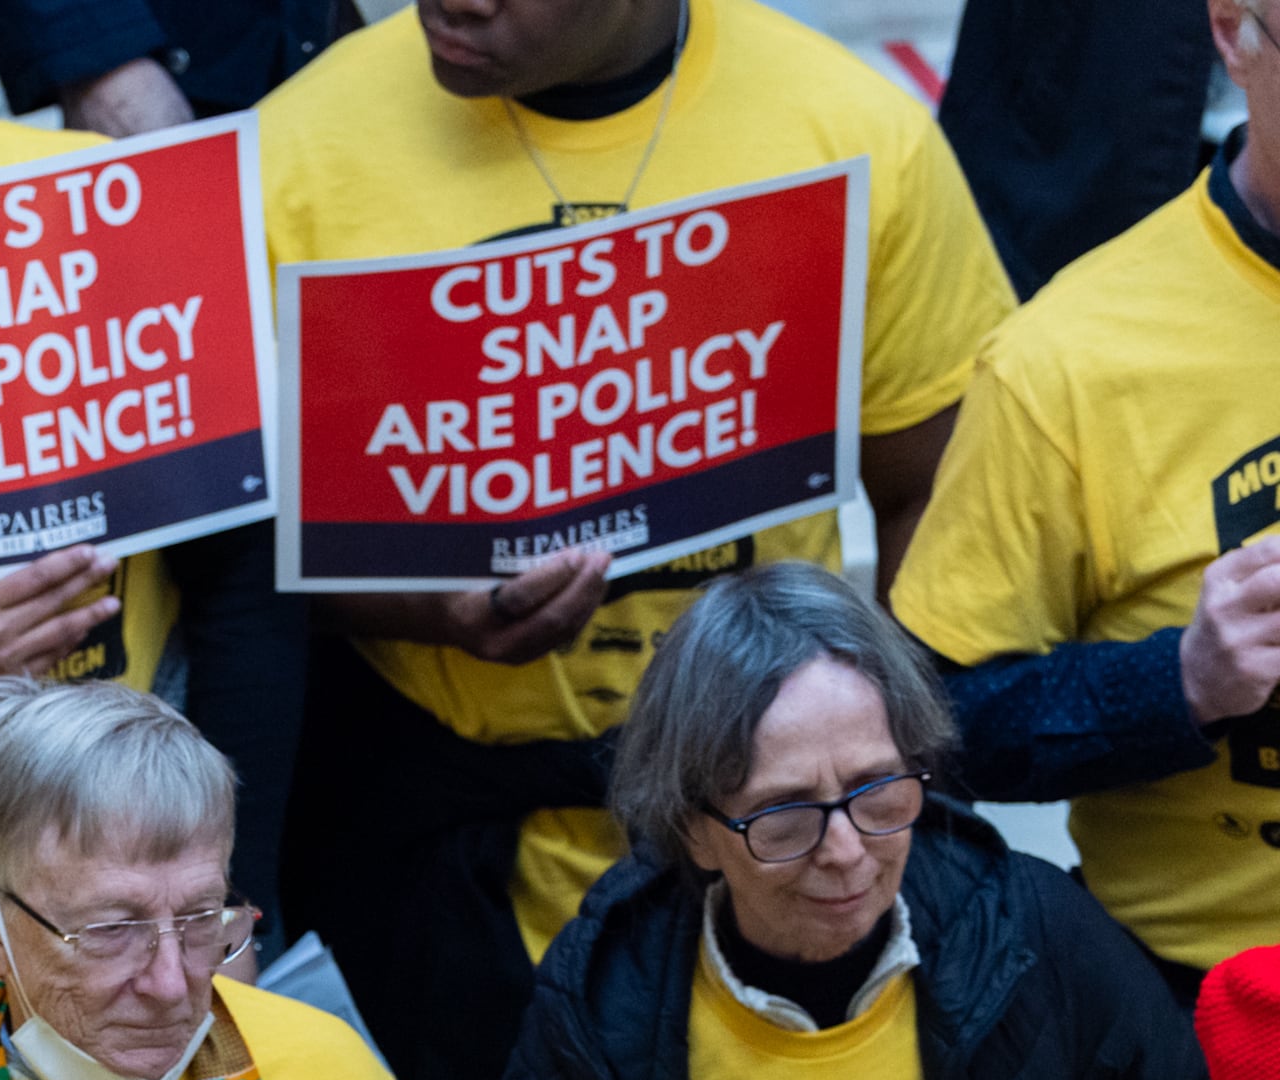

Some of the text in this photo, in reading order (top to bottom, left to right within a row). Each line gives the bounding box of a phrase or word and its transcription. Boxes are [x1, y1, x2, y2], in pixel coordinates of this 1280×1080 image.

[56, 163, 141, 236] TO
[430, 210, 729, 323] CUTS TO
[365, 320, 786, 455] ARE POLICY
[478, 290, 668, 384] SNAP
[388, 390, 758, 516] VIOLENCE!
[491, 503, 648, 558] REPAIRERS
